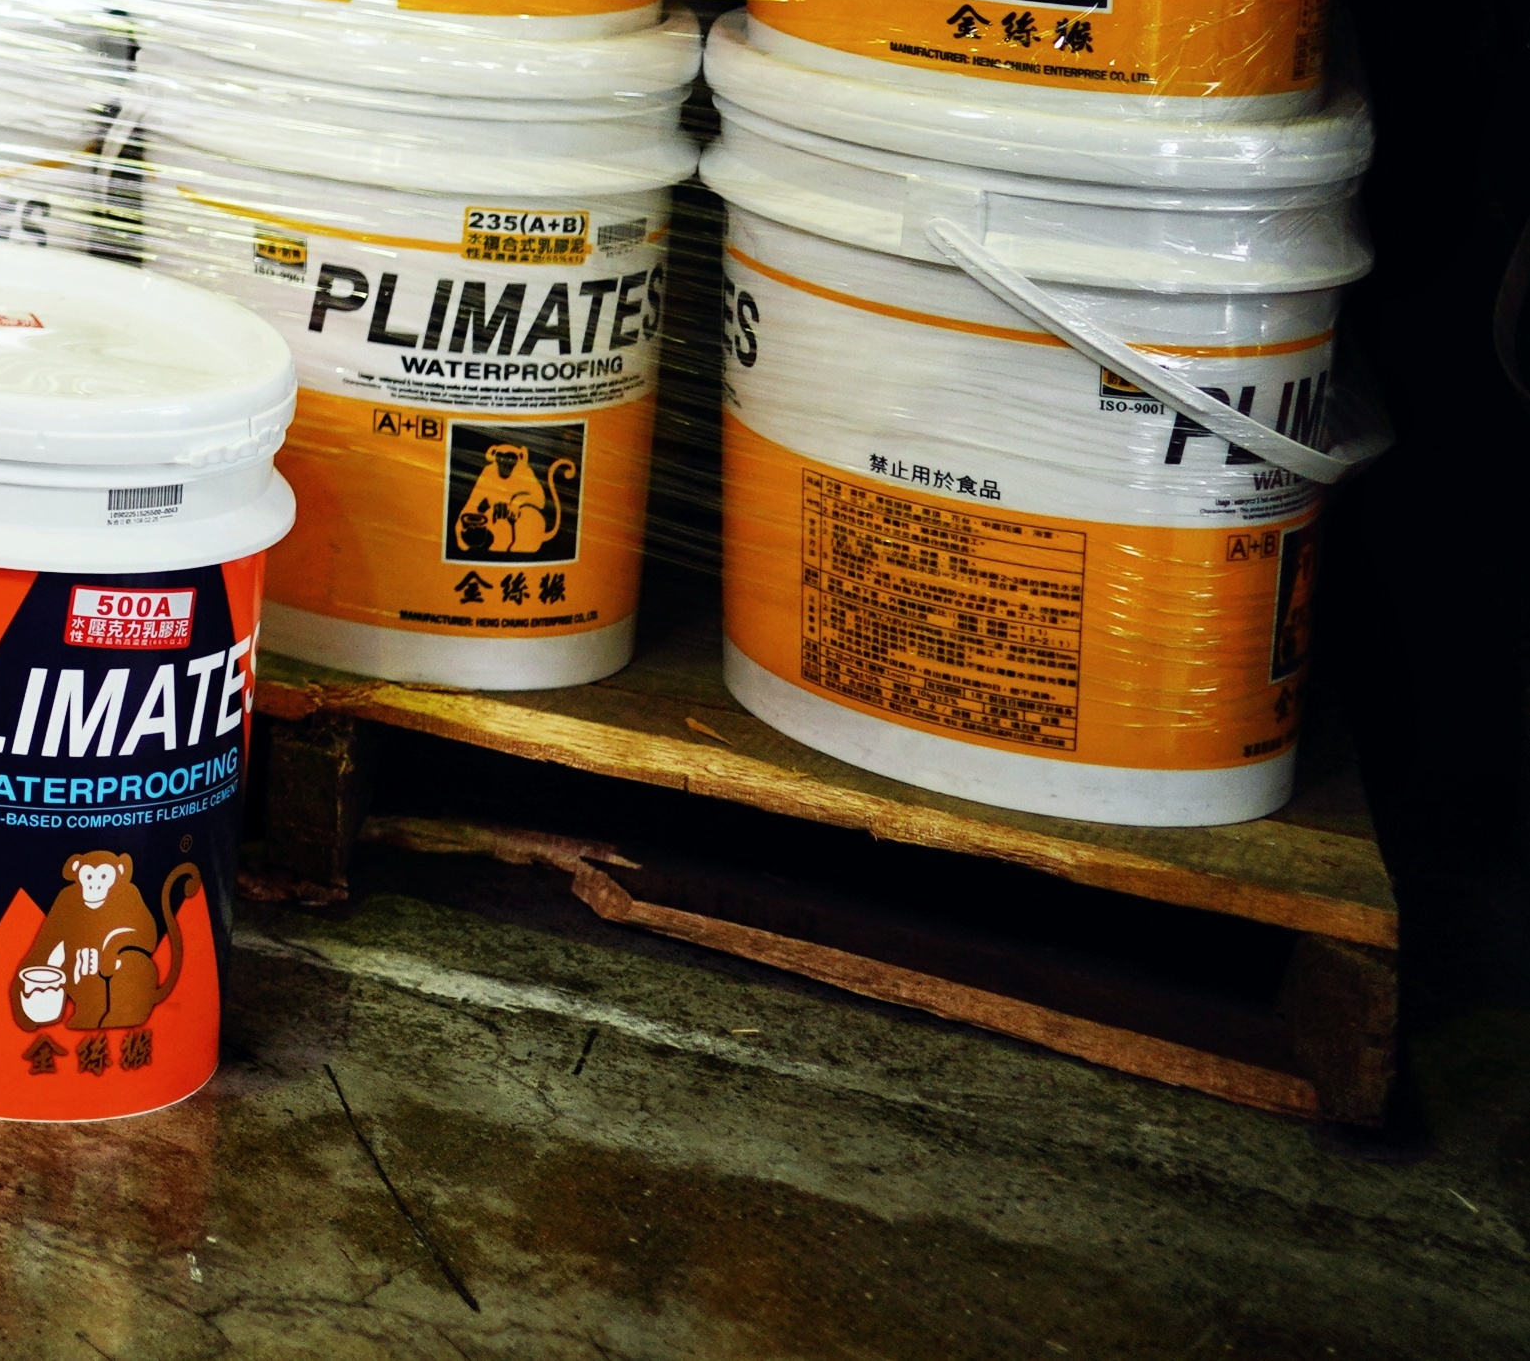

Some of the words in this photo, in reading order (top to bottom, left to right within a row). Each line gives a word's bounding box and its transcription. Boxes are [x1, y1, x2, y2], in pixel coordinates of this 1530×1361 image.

[890, 41, 970, 65] MANUFACTURER:
[1043, 64, 1108, 81] ENTERPRISE
[468, 211, 585, 235] 235(A+B)
[308, 262, 666, 356] PLIMATES
[401, 355, 623, 382] WATERPROOFING
[1099, 400, 1165, 415] ISO-9001
[869, 453, 1001, 500] 禁止用於食品
[96, 594, 172, 618] 500A
[66, 811, 154, 829] COMPOSITE
[156, 802, 208, 822] FLEXIBLE
[210, 780, 239, 806] CEMENT
